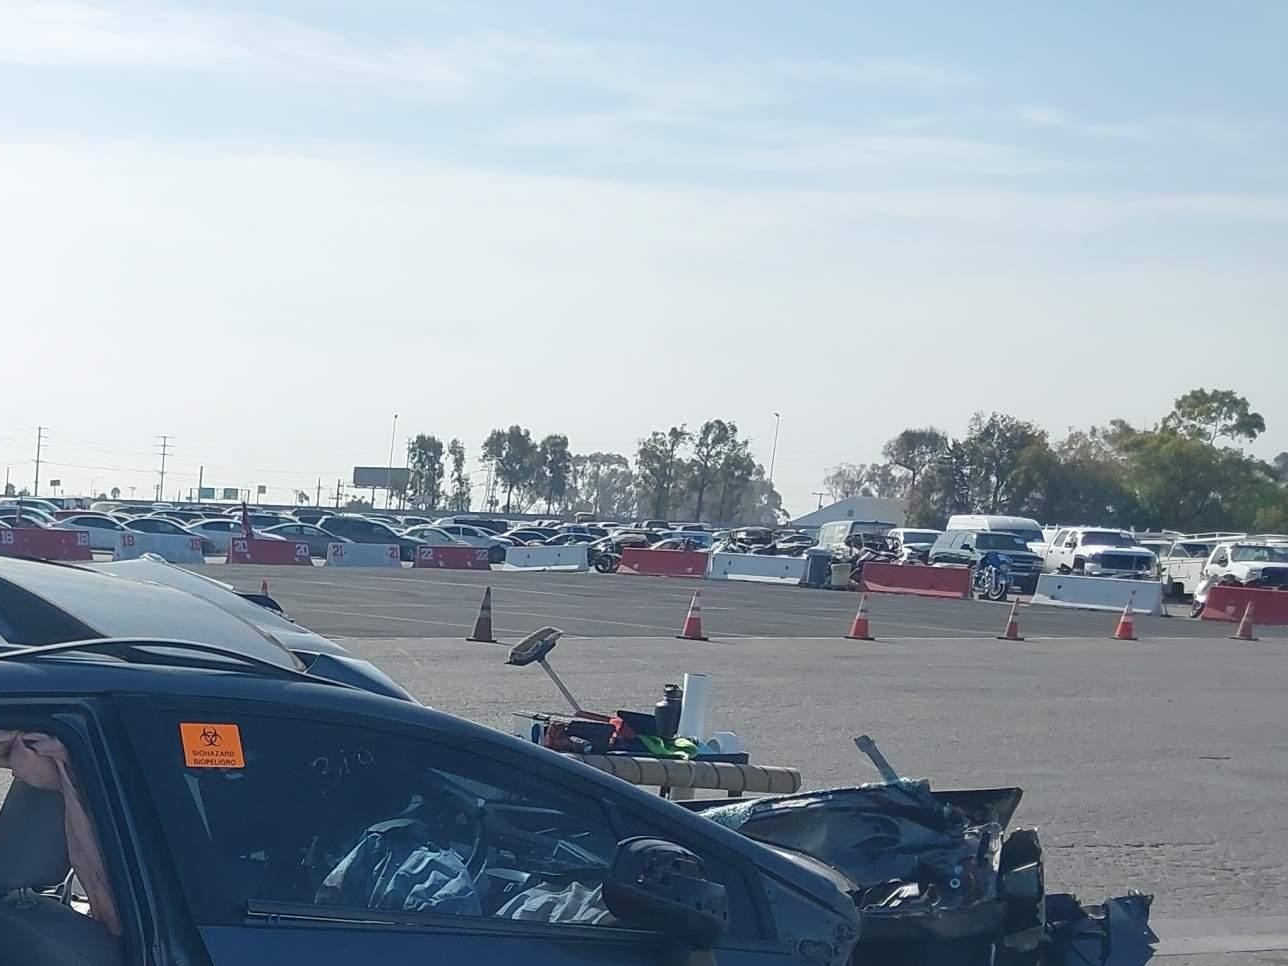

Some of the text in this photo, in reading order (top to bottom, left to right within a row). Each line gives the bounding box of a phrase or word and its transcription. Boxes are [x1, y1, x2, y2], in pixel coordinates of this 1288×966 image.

[233, 540, 249, 553] 20
[296, 542, 311, 556] 20
[333, 545, 345, 558] 21
[388, 545, 400, 558] 21
[420, 547, 434, 560] 22
[475, 548, 490, 561] 22
[193, 758, 237, 766] BIOPELIGRO
